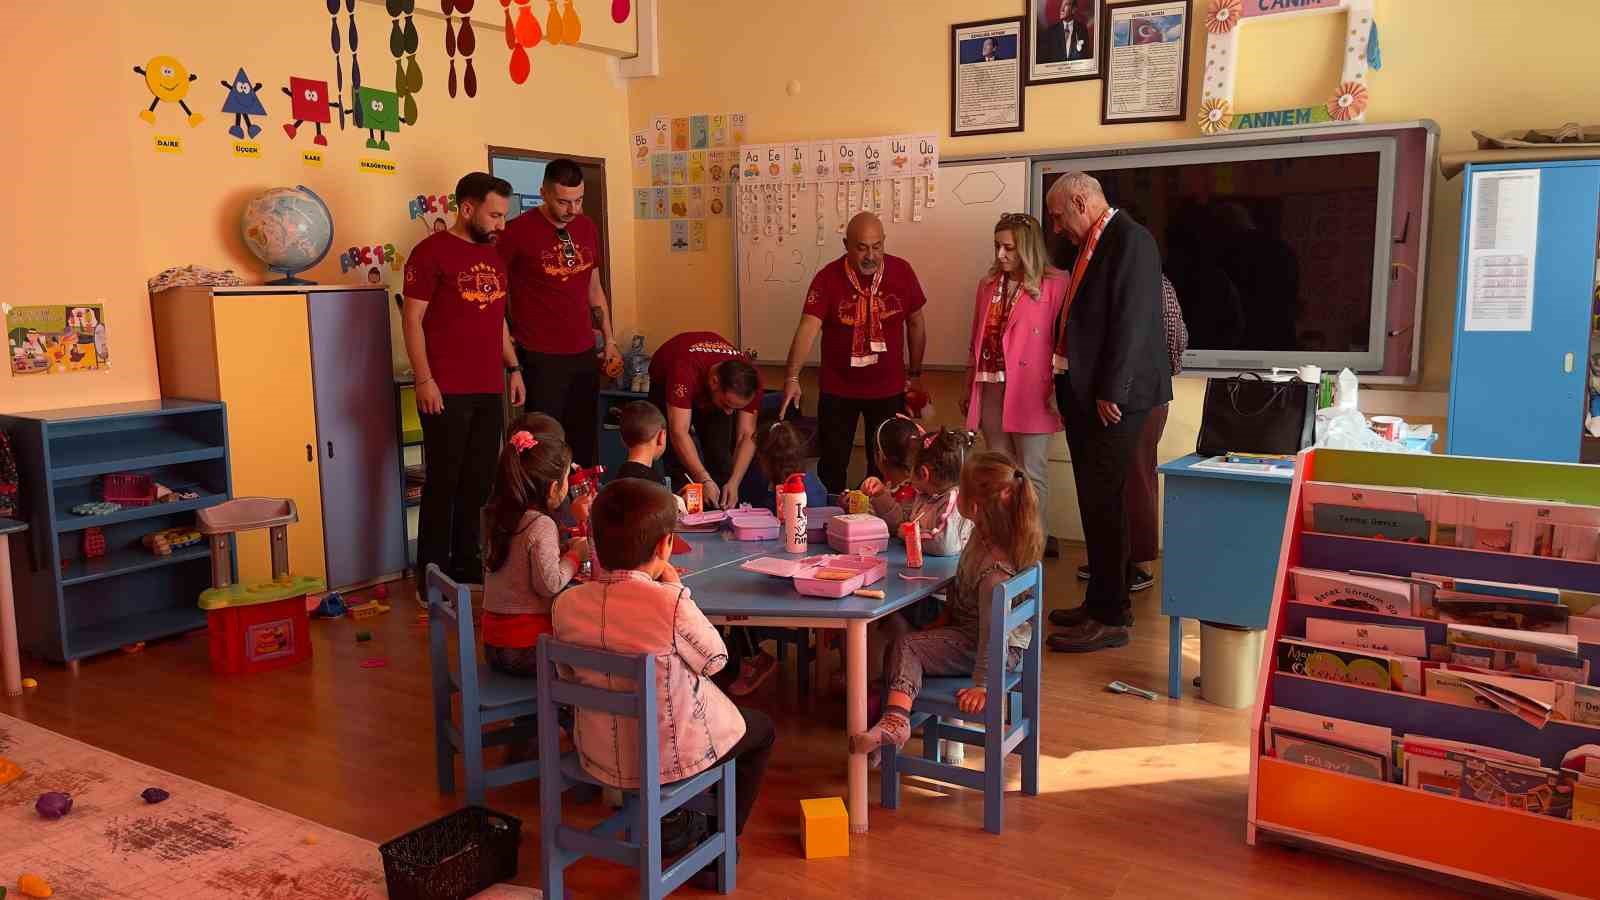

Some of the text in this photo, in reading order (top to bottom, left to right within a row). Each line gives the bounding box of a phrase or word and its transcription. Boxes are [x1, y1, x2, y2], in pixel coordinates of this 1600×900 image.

[1258, 0, 1321, 11] CAN
[1238, 107, 1313, 129] ANNEM
[635, 134, 648, 146] Bb
[892, 140, 905, 153] Uu
[745, 151, 760, 163] Aa
[768, 149, 781, 162] Ee
[839, 145, 854, 158] Oo
[341, 247, 373, 273] ABC
